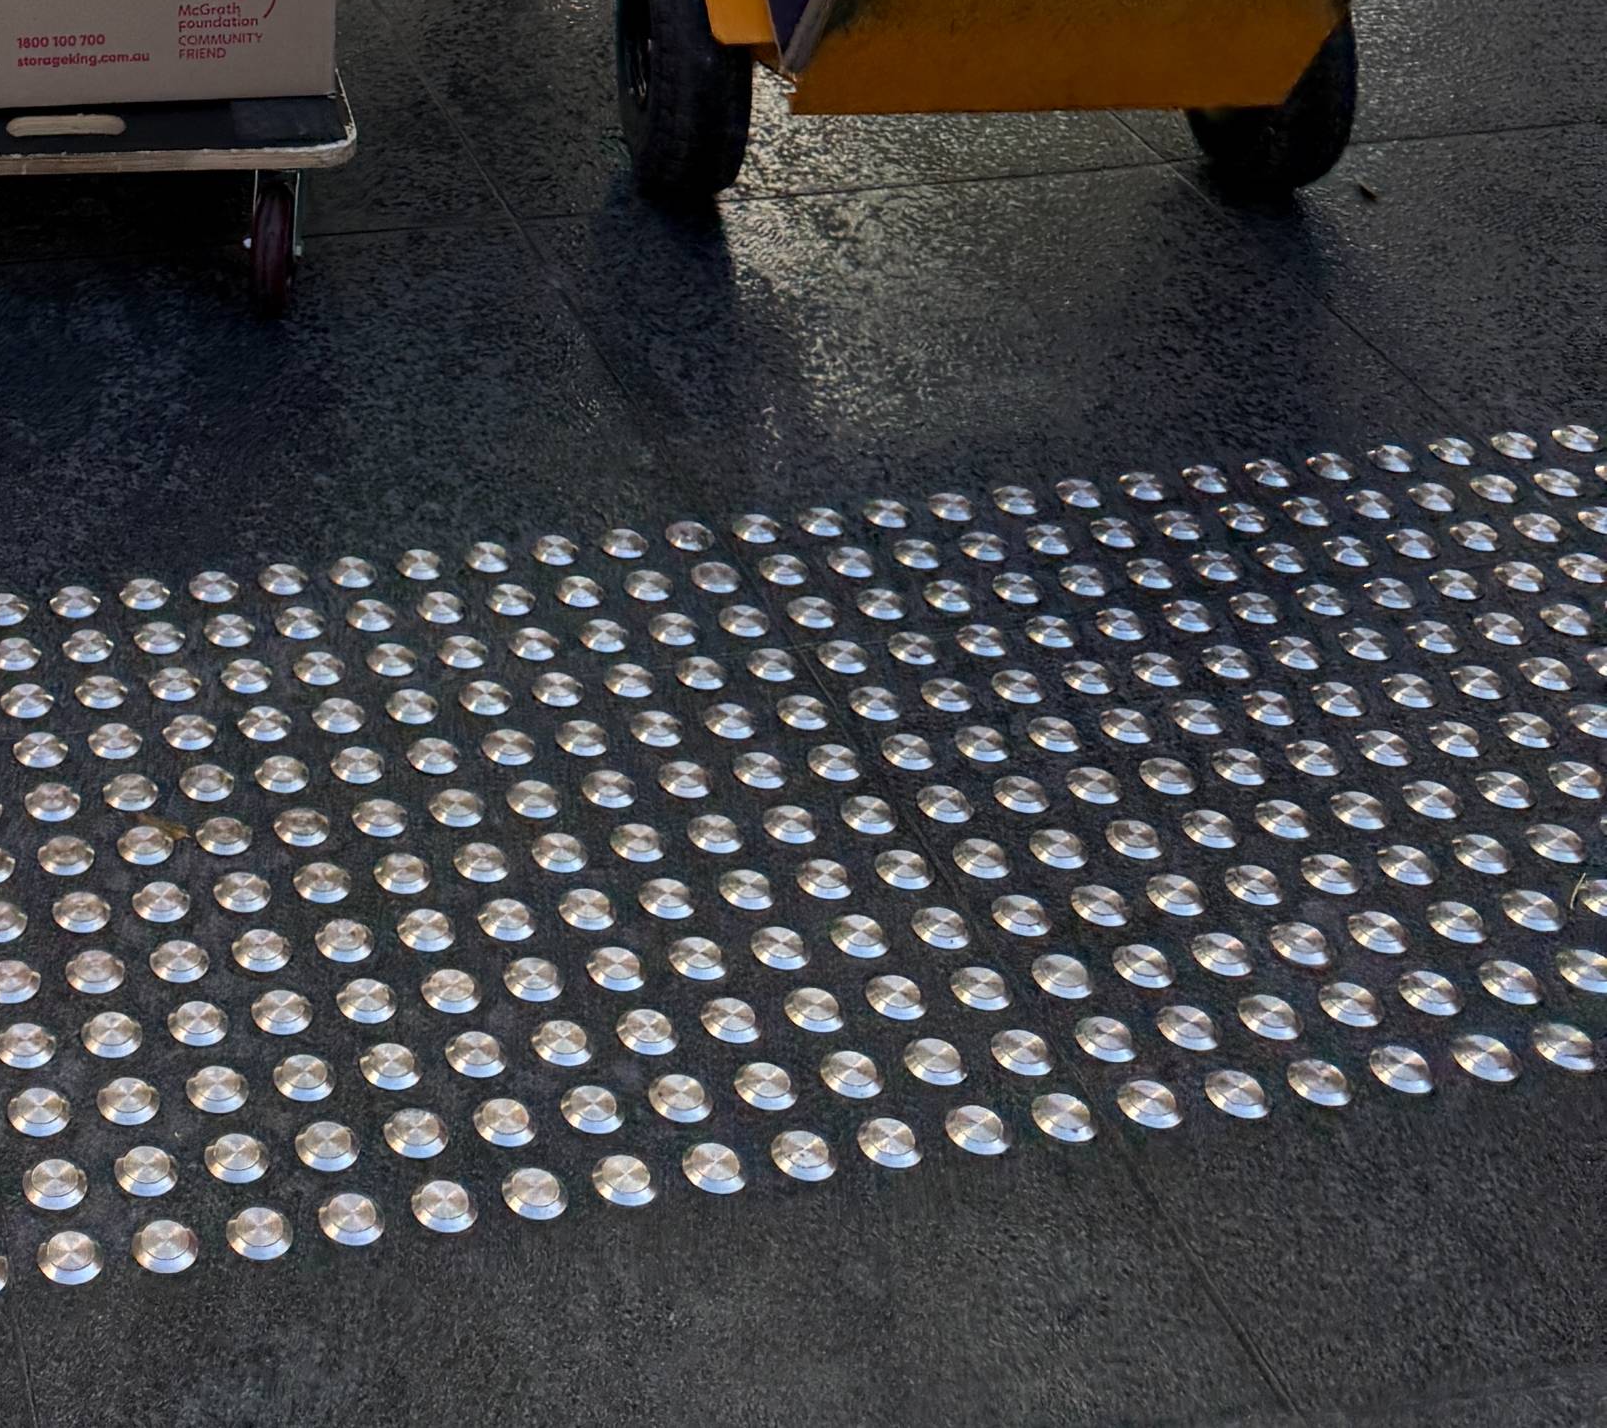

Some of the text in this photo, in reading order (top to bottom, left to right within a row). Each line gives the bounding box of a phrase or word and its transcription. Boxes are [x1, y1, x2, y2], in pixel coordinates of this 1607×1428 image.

[178, 2, 241, 16] McGrath
[178, 16, 259, 33] Foundation
[16, 33, 106, 49] 1800 100 700
[178, 32, 263, 46] COMMUNITY
[17, 52, 150, 68] storageking.com.au
[178, 47, 227, 60] FRIEND
